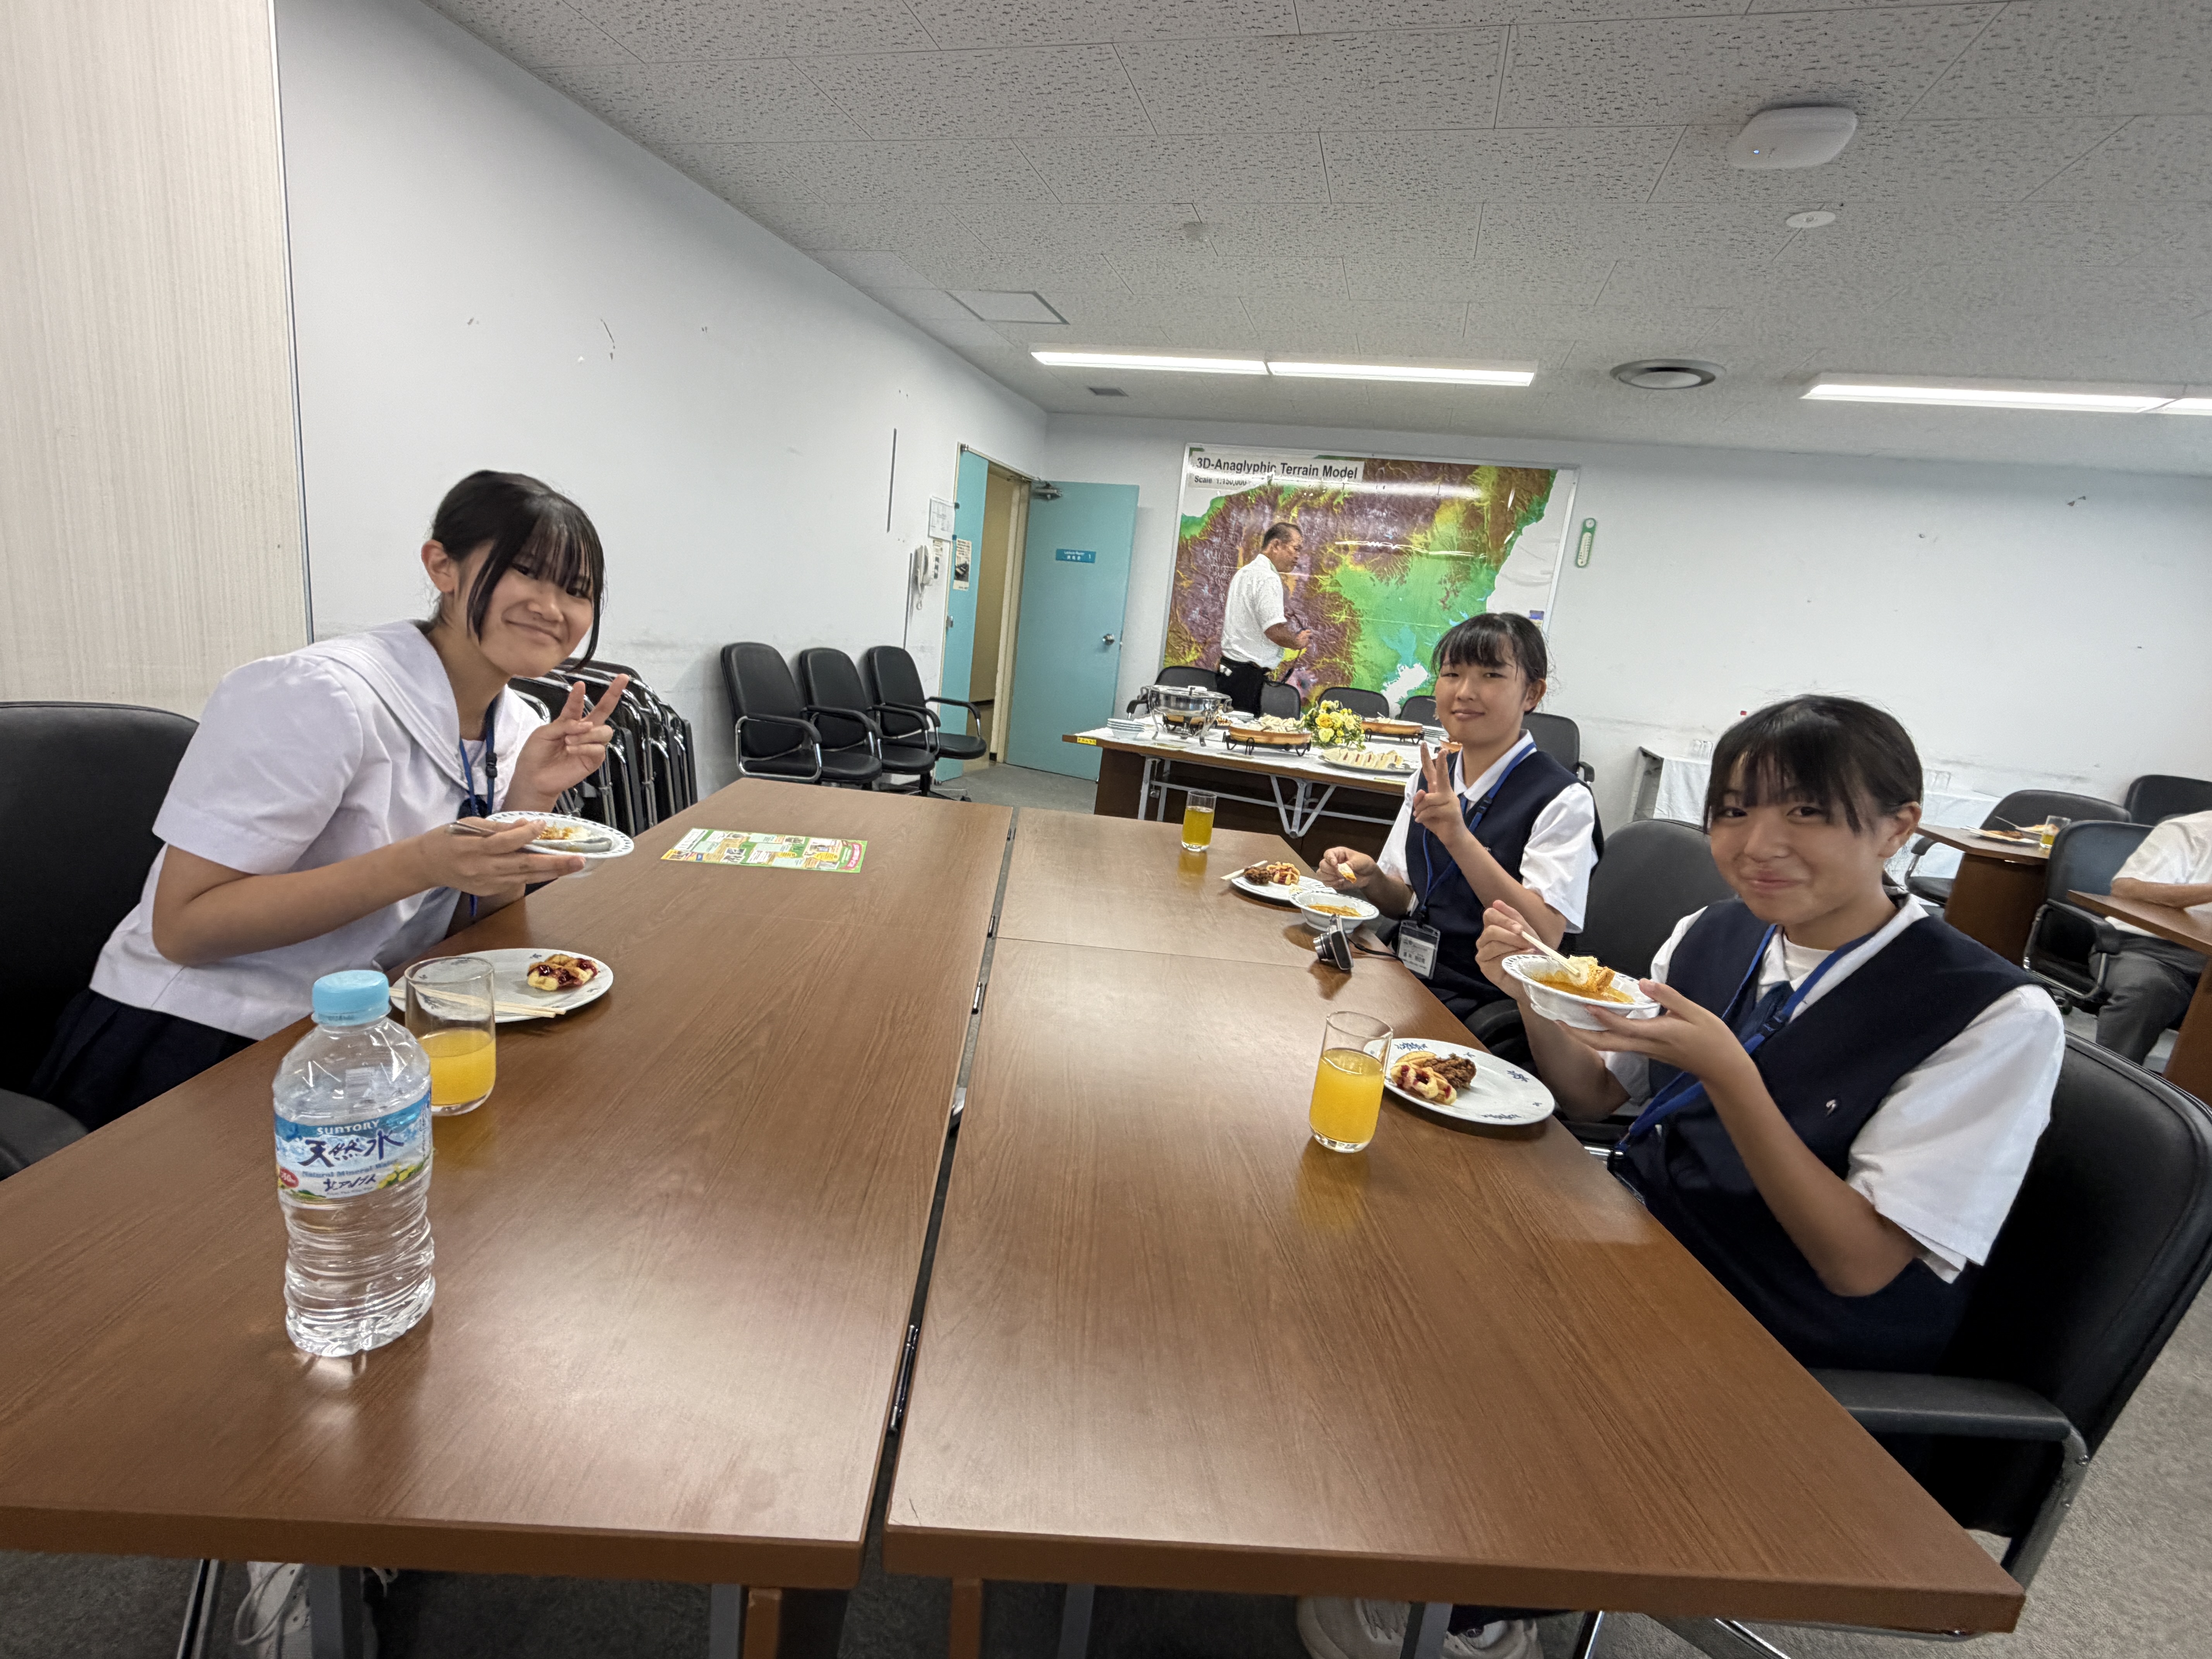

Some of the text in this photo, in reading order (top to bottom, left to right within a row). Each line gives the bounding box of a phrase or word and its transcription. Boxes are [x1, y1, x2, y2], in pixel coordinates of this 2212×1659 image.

[1196, 457, 1358, 479] 3D-Anaglyphic Terrain Model
[1194, 475, 1212, 484] Scale
[317, 1119, 380, 1135] SUNTORY
[297, 1130, 404, 1168] 天然水
